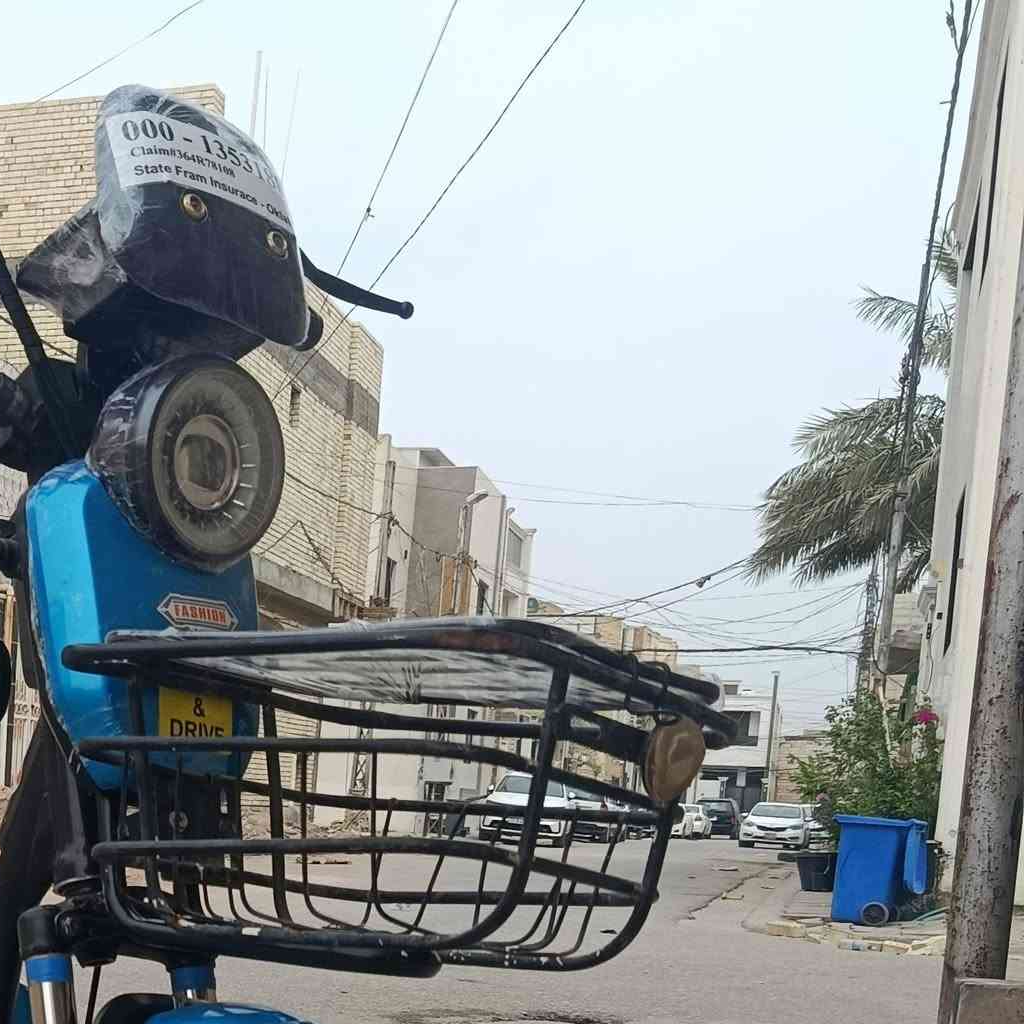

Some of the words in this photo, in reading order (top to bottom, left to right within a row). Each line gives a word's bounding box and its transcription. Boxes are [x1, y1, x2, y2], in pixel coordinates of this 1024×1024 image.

[122, 118, 175, 142] 000
[134, 164, 172, 177] State
[175, 165, 208, 184] Fram
[175, 604, 226, 625] FASHION
[193, 697, 206, 718] &
[169, 717, 225, 738] DRIVE
